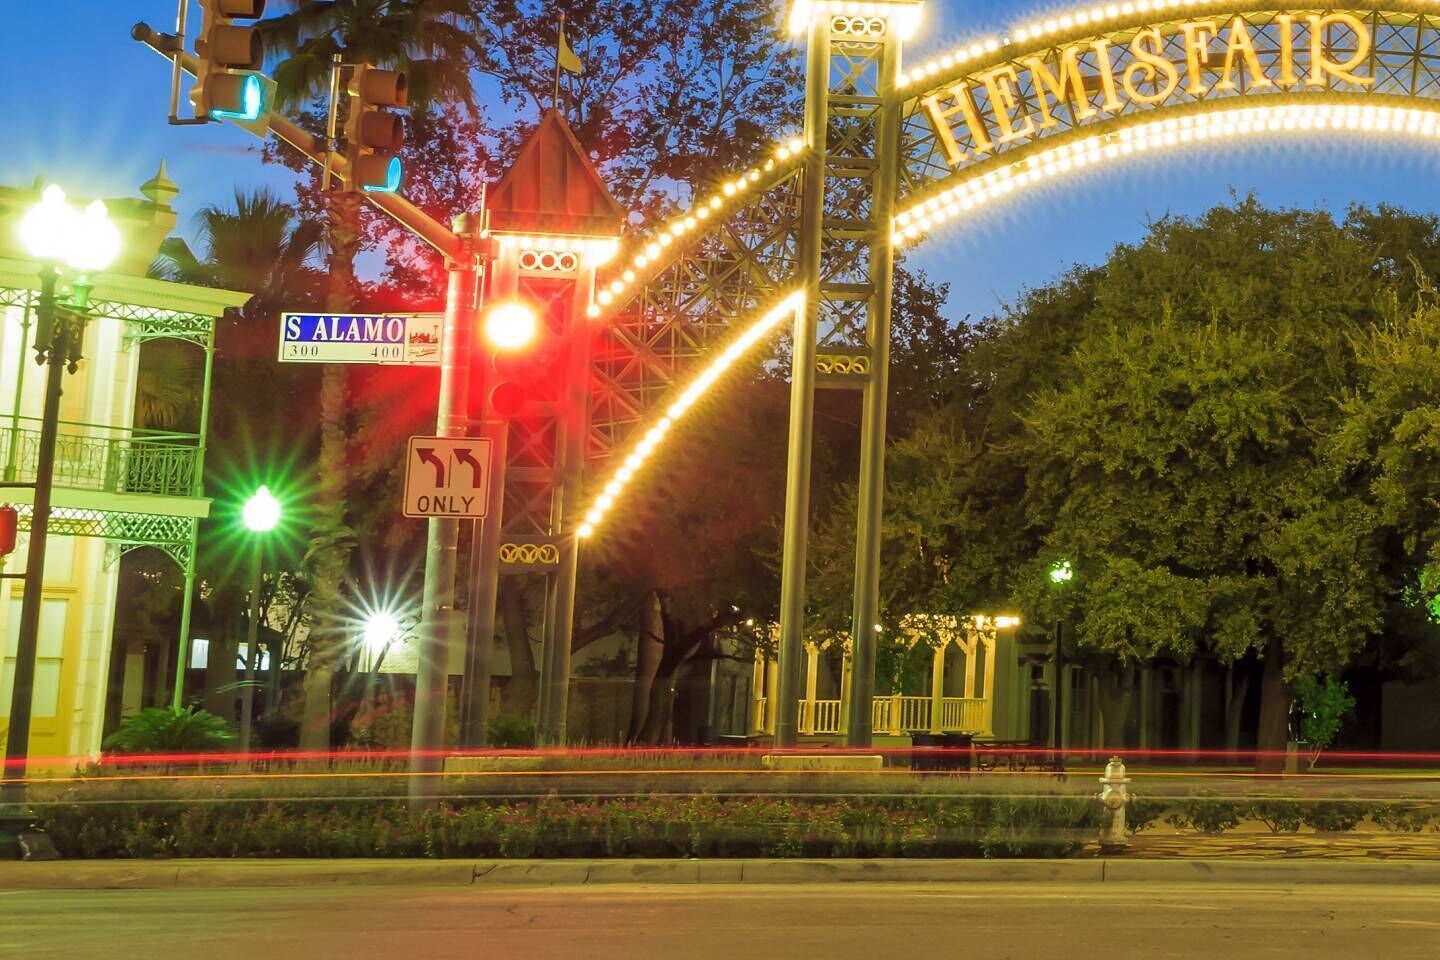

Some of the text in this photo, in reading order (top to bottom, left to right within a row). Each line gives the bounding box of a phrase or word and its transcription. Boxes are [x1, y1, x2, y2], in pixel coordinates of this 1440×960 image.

[920, 13, 1376, 166] HEMISFAIR
[286, 316, 404, 342] S ALAMO
[289, 344, 319, 357] 300
[371, 346, 399, 358] 400
[417, 495, 475, 513] ONLY
